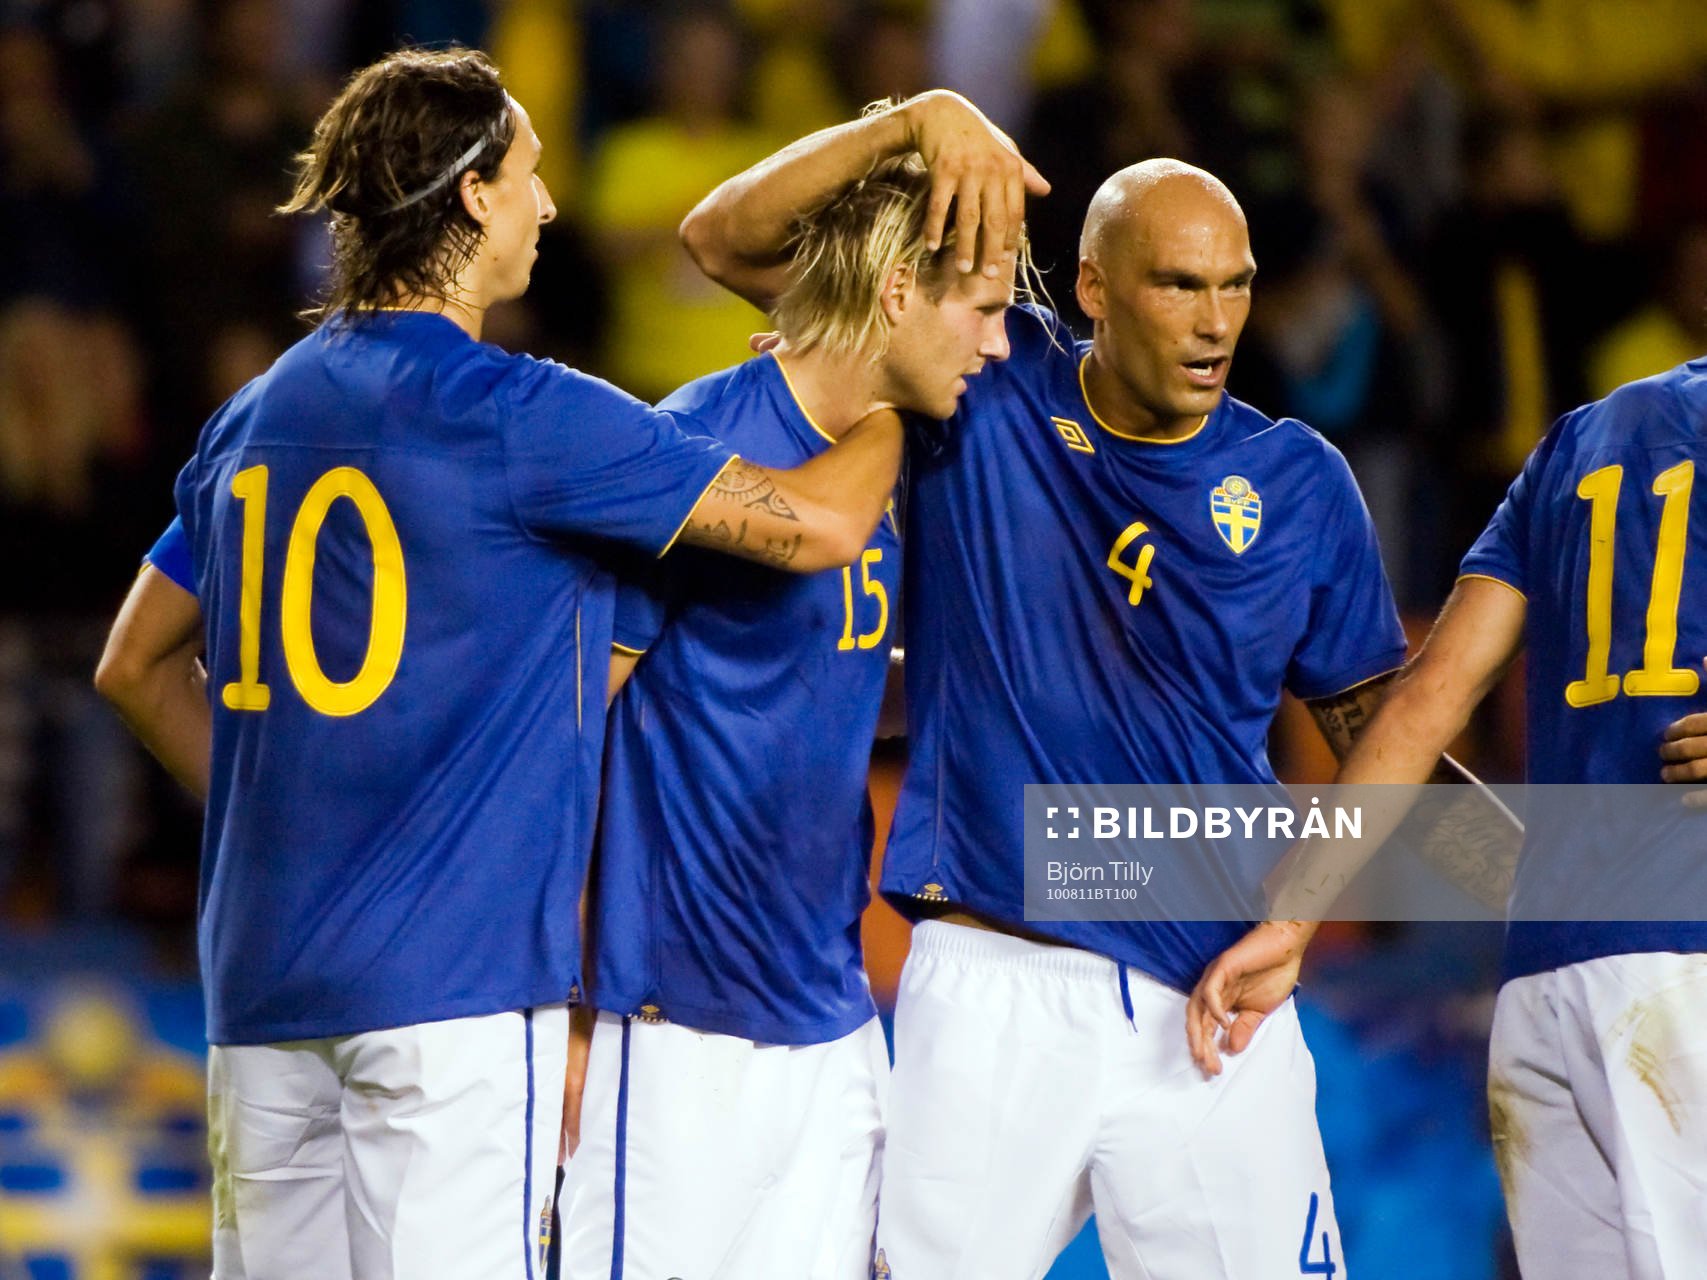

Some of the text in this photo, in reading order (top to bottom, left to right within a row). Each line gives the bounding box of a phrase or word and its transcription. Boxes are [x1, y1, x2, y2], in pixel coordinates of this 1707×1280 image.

[222, 465, 407, 717] 10
[838, 548, 889, 650] 15
[1107, 521, 1155, 606] 4
[1565, 460, 1700, 708] 11
[1299, 1191, 1336, 1280] 4
